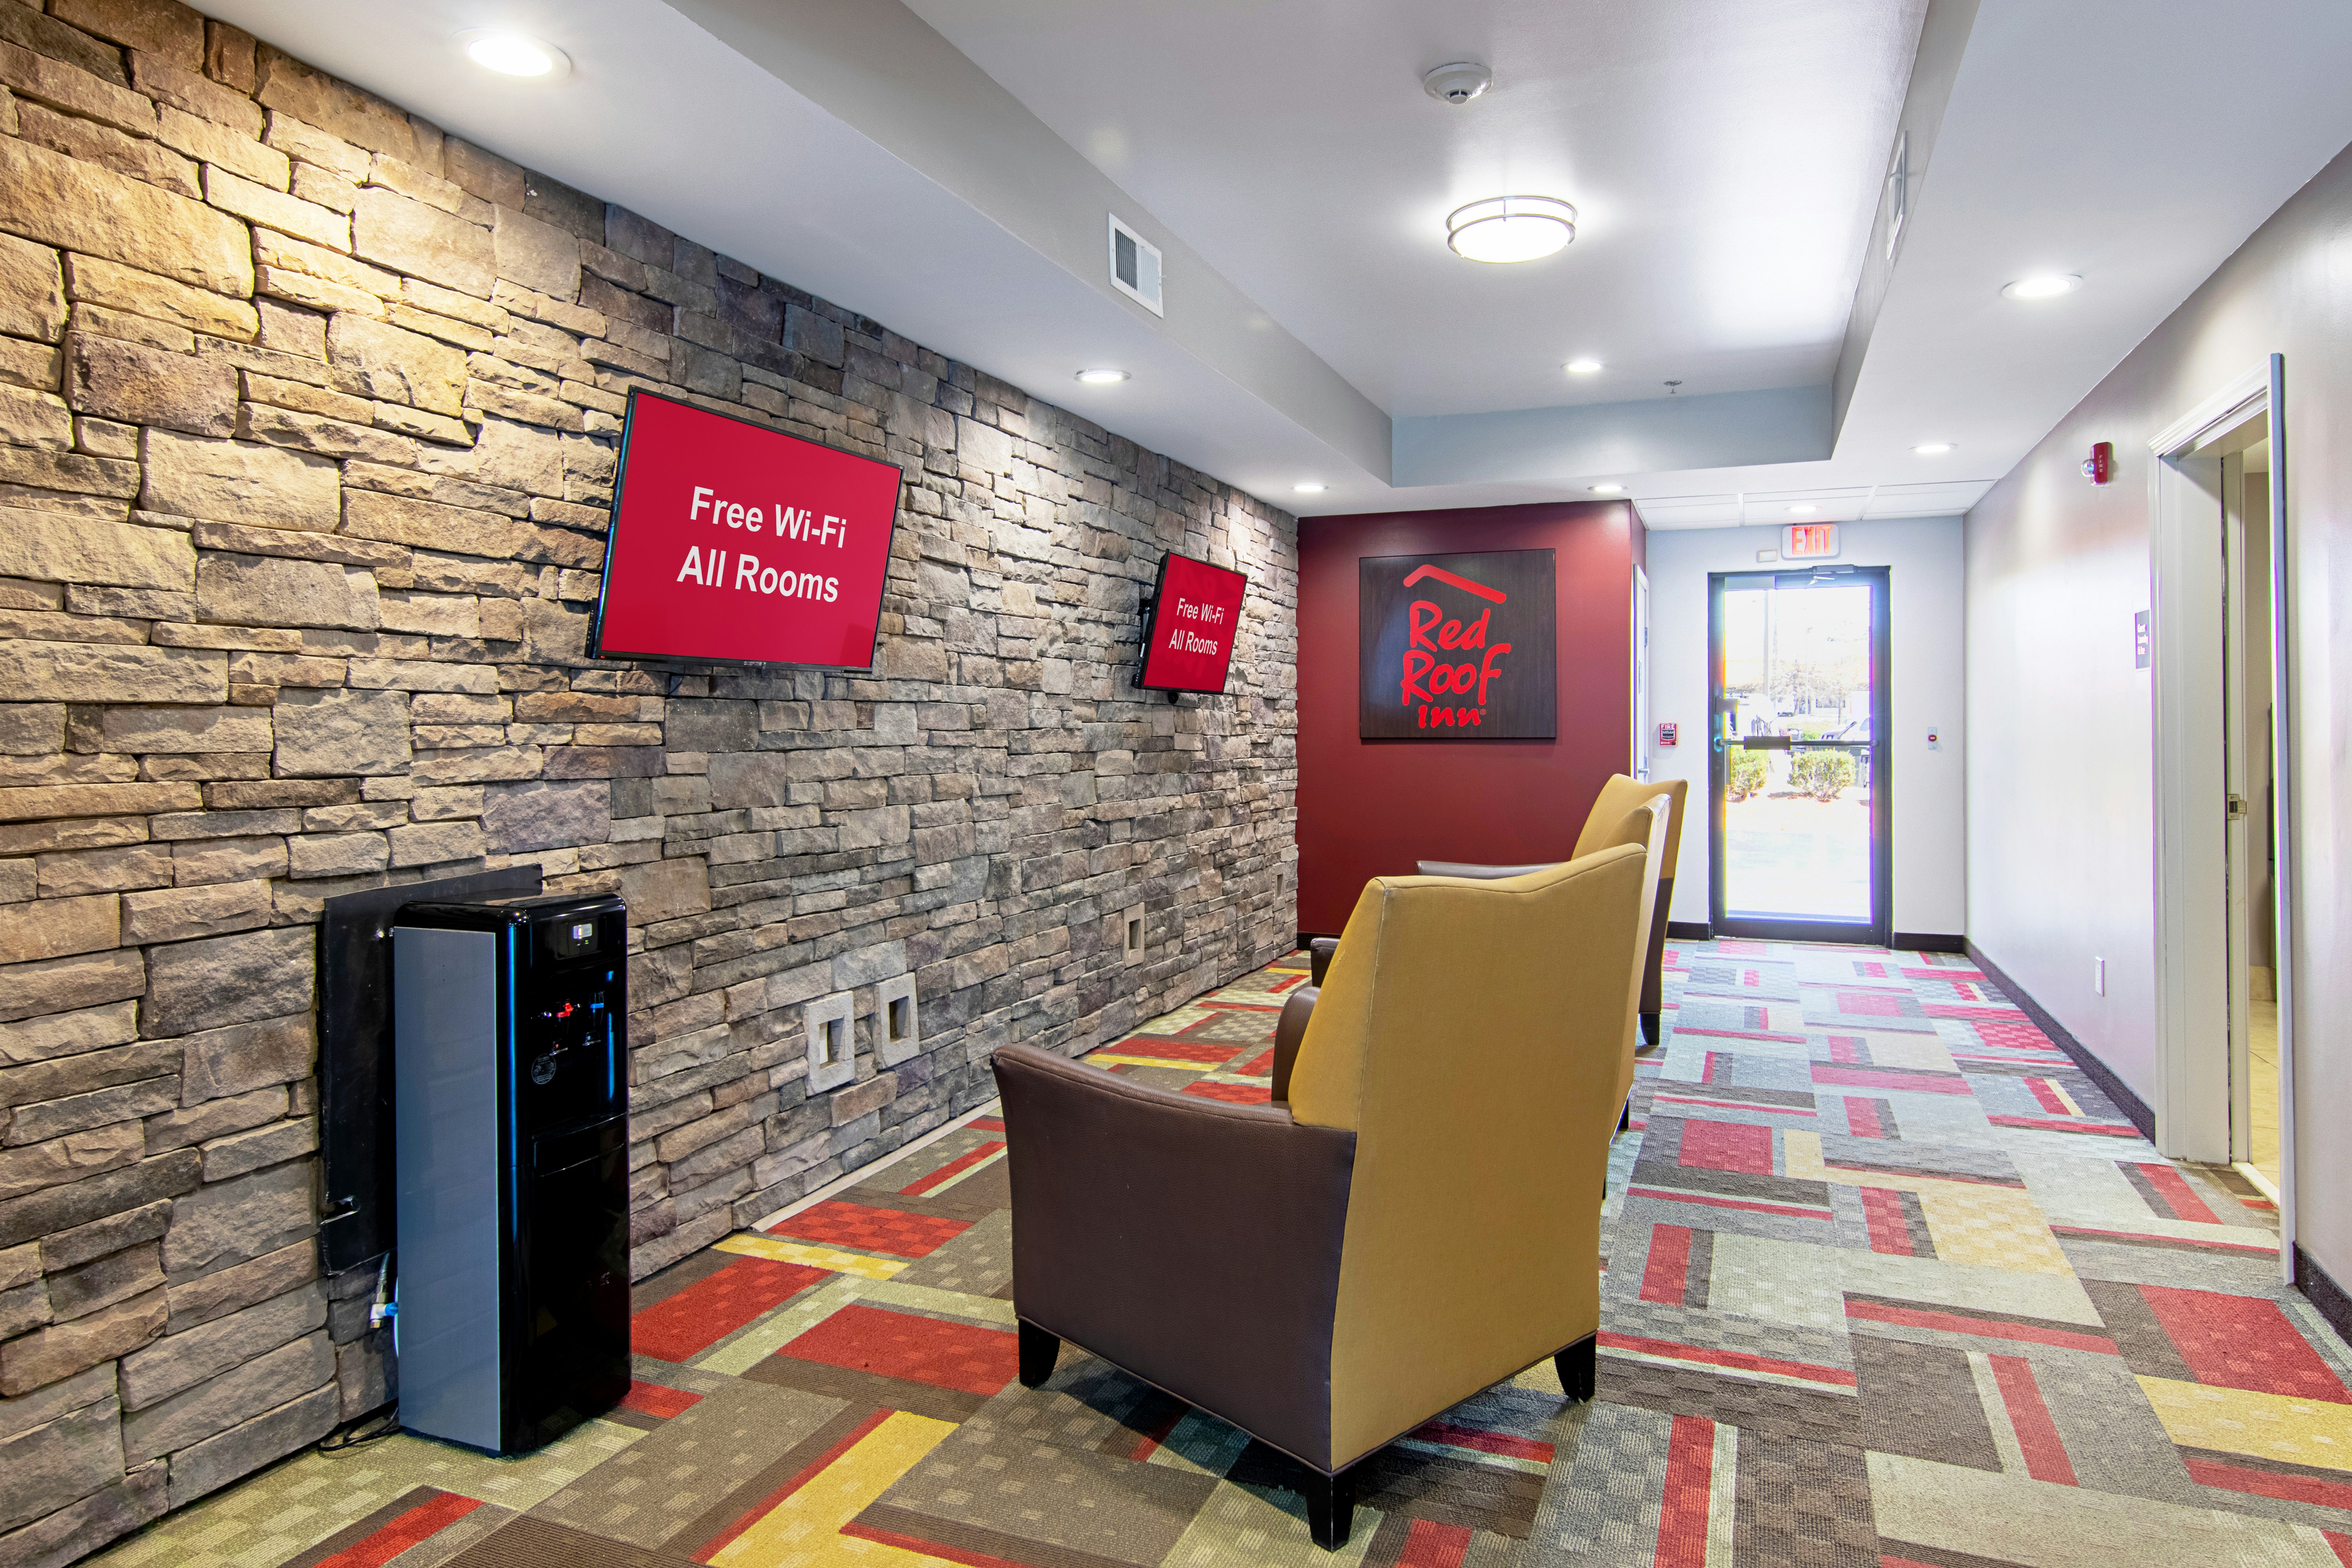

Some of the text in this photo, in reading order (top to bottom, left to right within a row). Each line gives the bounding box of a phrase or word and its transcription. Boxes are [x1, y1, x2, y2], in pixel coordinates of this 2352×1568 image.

[690, 486, 847, 548] Free Wi-Fi
[1791, 525, 1832, 555] EXIT
[676, 546, 839, 603] All Rooms
[1177, 597, 1225, 625] Free Wi-Fi
[1409, 600, 1491, 652] Red
[1168, 629, 1217, 655] All Rooms
[1400, 643, 1511, 706] Roof
